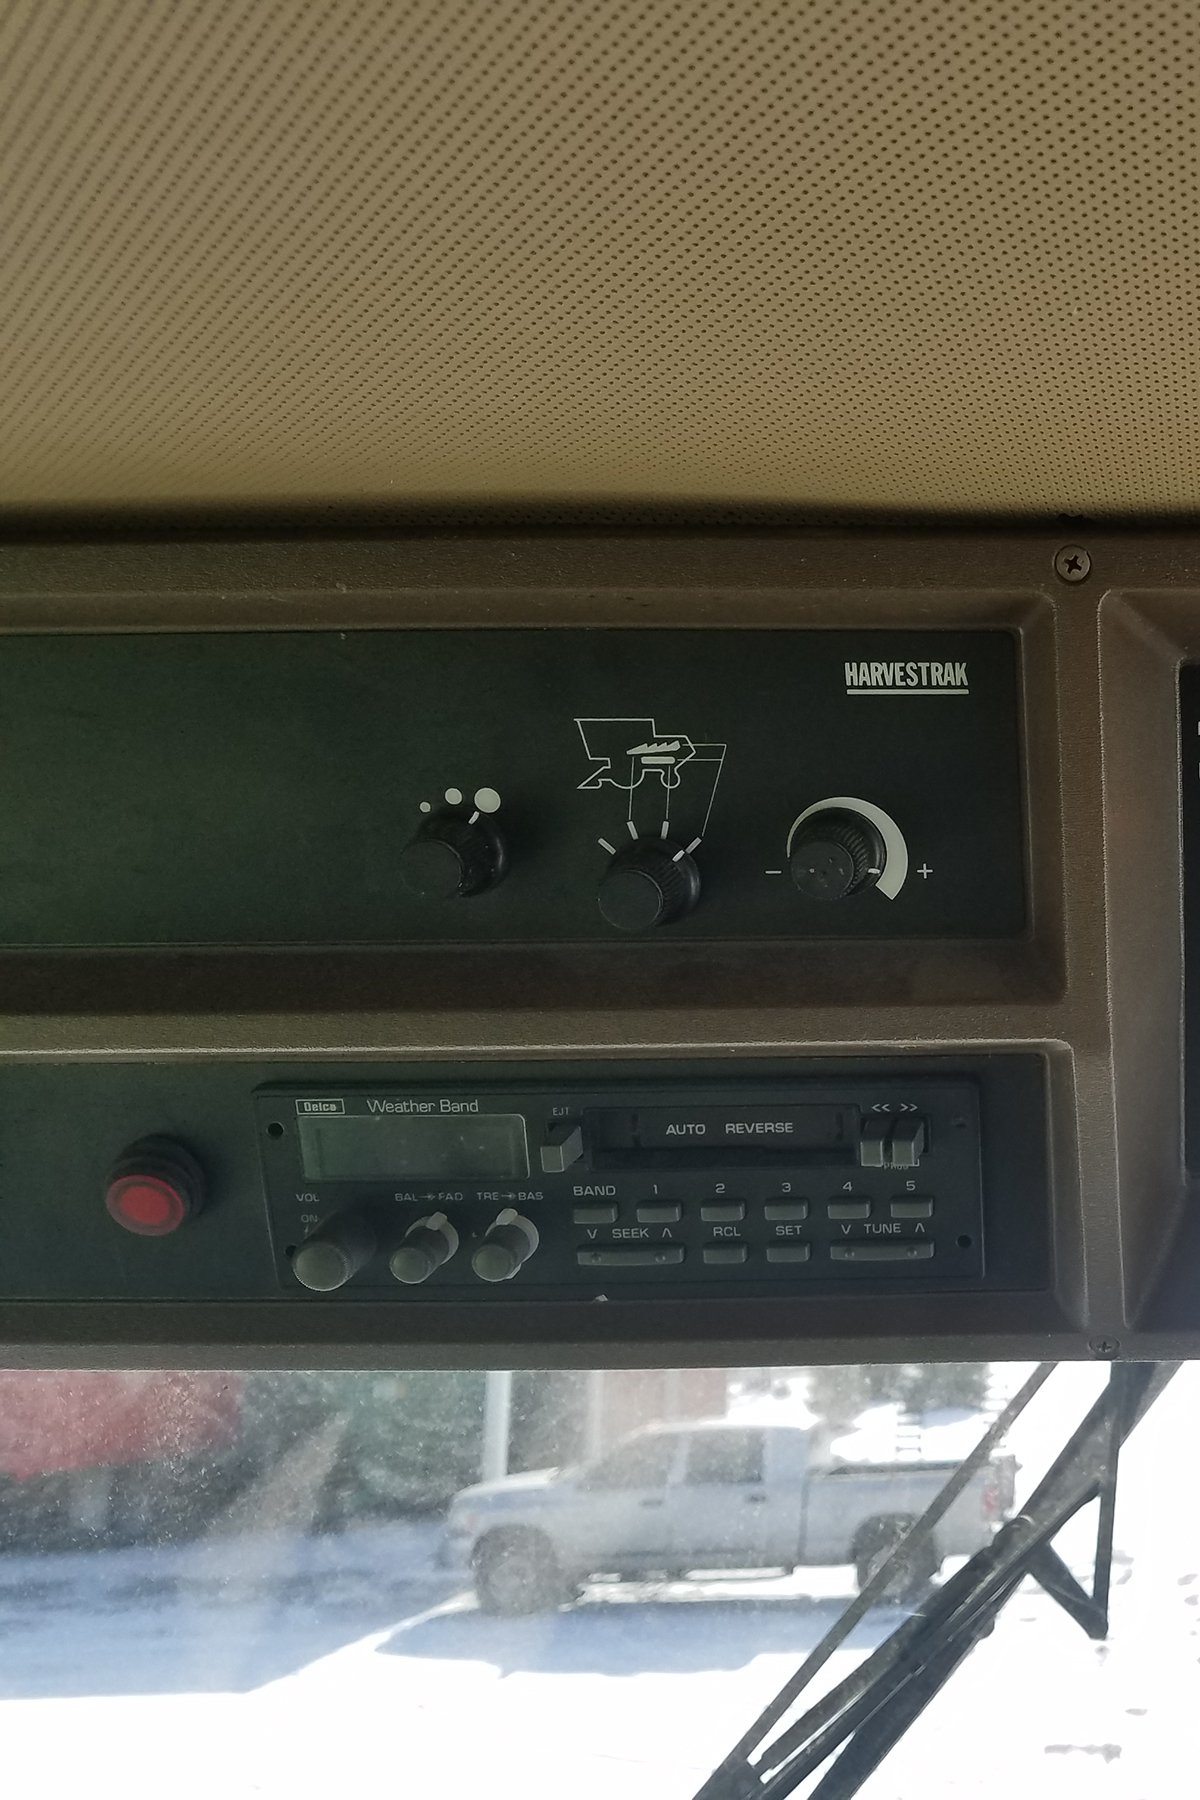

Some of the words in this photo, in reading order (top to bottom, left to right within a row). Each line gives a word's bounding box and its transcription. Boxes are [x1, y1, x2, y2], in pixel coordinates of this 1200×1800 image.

[844, 661, 969, 688] HARVESTRAK
[303, 1101, 338, 1113] Delco
[366, 1099, 437, 1113] Weather
[439, 1098, 480, 1113] Band
[665, 1123, 706, 1136] AUTO
[725, 1122, 794, 1134] REVERSE
[572, 1185, 616, 1196] BAND
[652, 1184, 659, 1195] 1
[715, 1182, 726, 1194] 2
[781, 1182, 792, 1193] 3
[842, 1181, 853, 1192] 4
[905, 1180, 916, 1191] 5
[295, 1192, 320, 1202] VOL
[394, 1192, 419, 1202] BAL
[438, 1191, 464, 1201] FAD
[476, 1191, 499, 1201] TRE
[517, 1191, 544, 1201] BAS
[611, 1227, 650, 1239] SEEK
[713, 1226, 742, 1238] RCL
[775, 1225, 803, 1237] SET
[863, 1222, 902, 1235] TUNE
